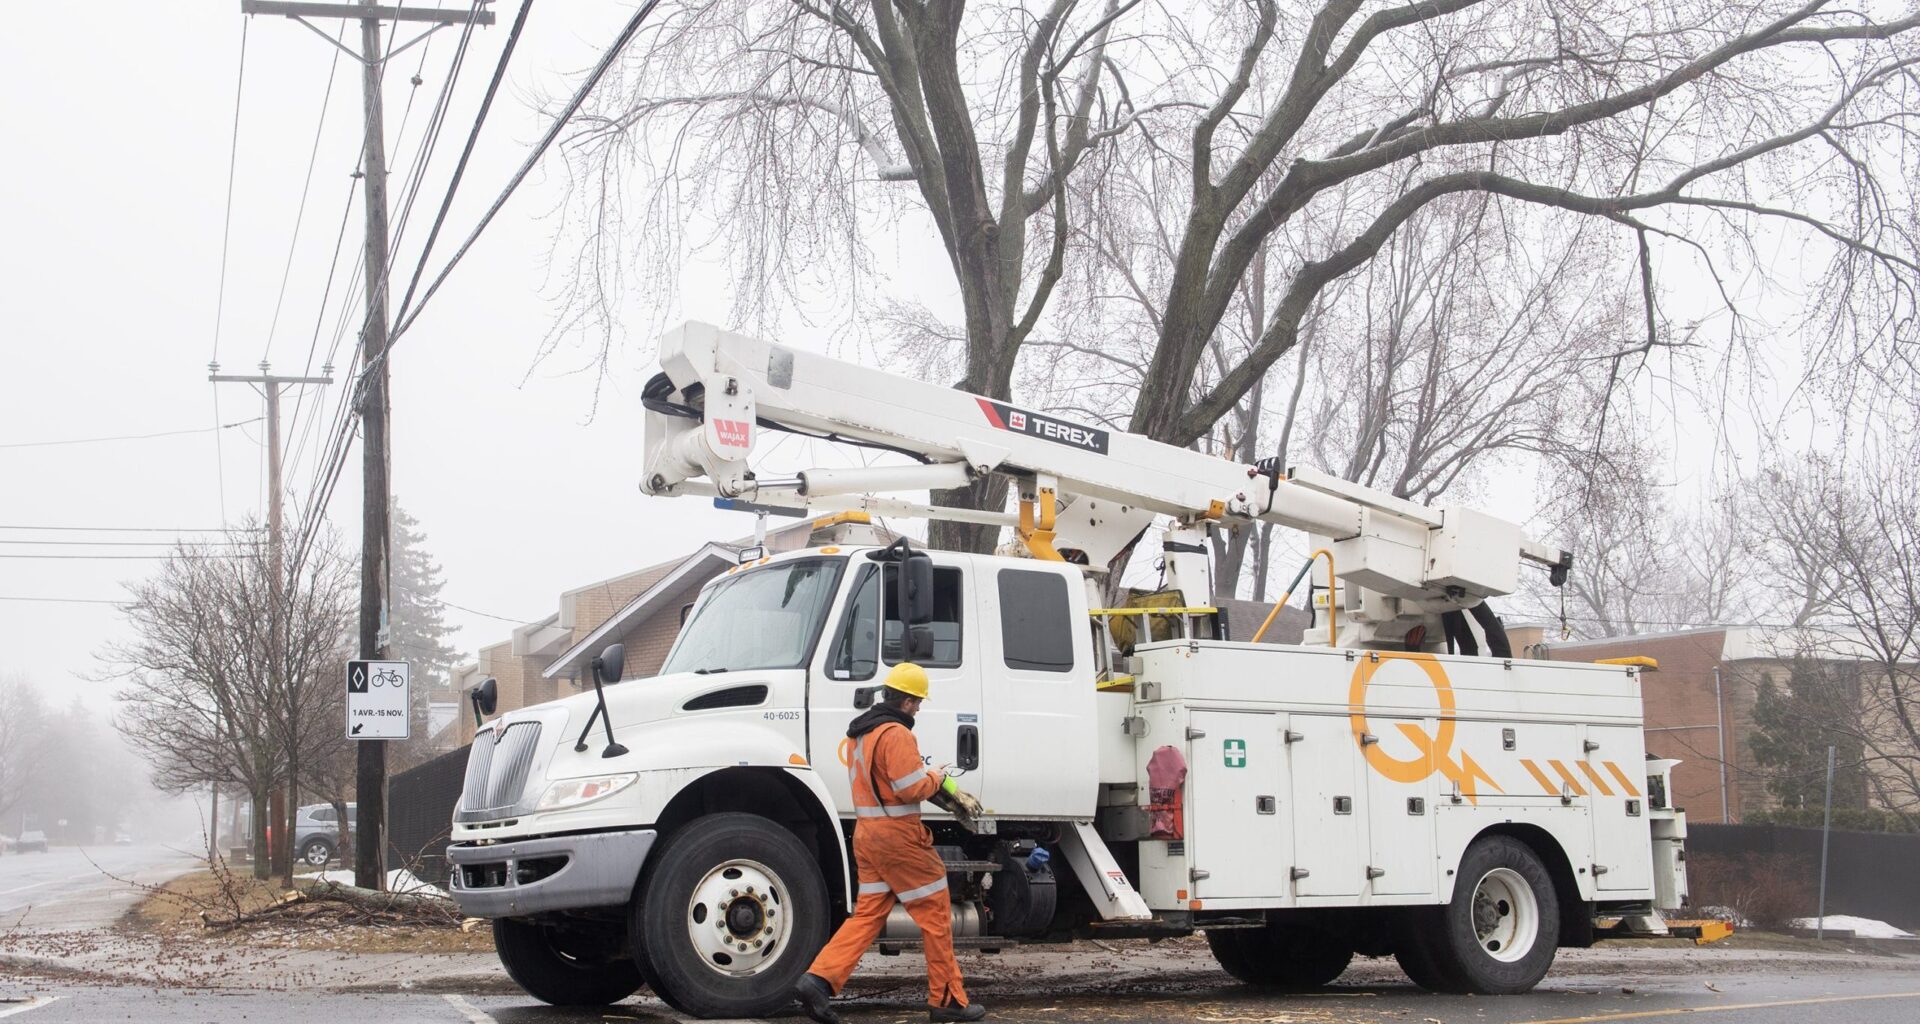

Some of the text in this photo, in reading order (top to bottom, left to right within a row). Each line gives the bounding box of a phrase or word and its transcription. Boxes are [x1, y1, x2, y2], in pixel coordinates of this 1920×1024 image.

[720, 431, 746, 442] WAJAX
[386, 709, 404, 717] NOV.
[763, 711, 800, 720] 40-6025
